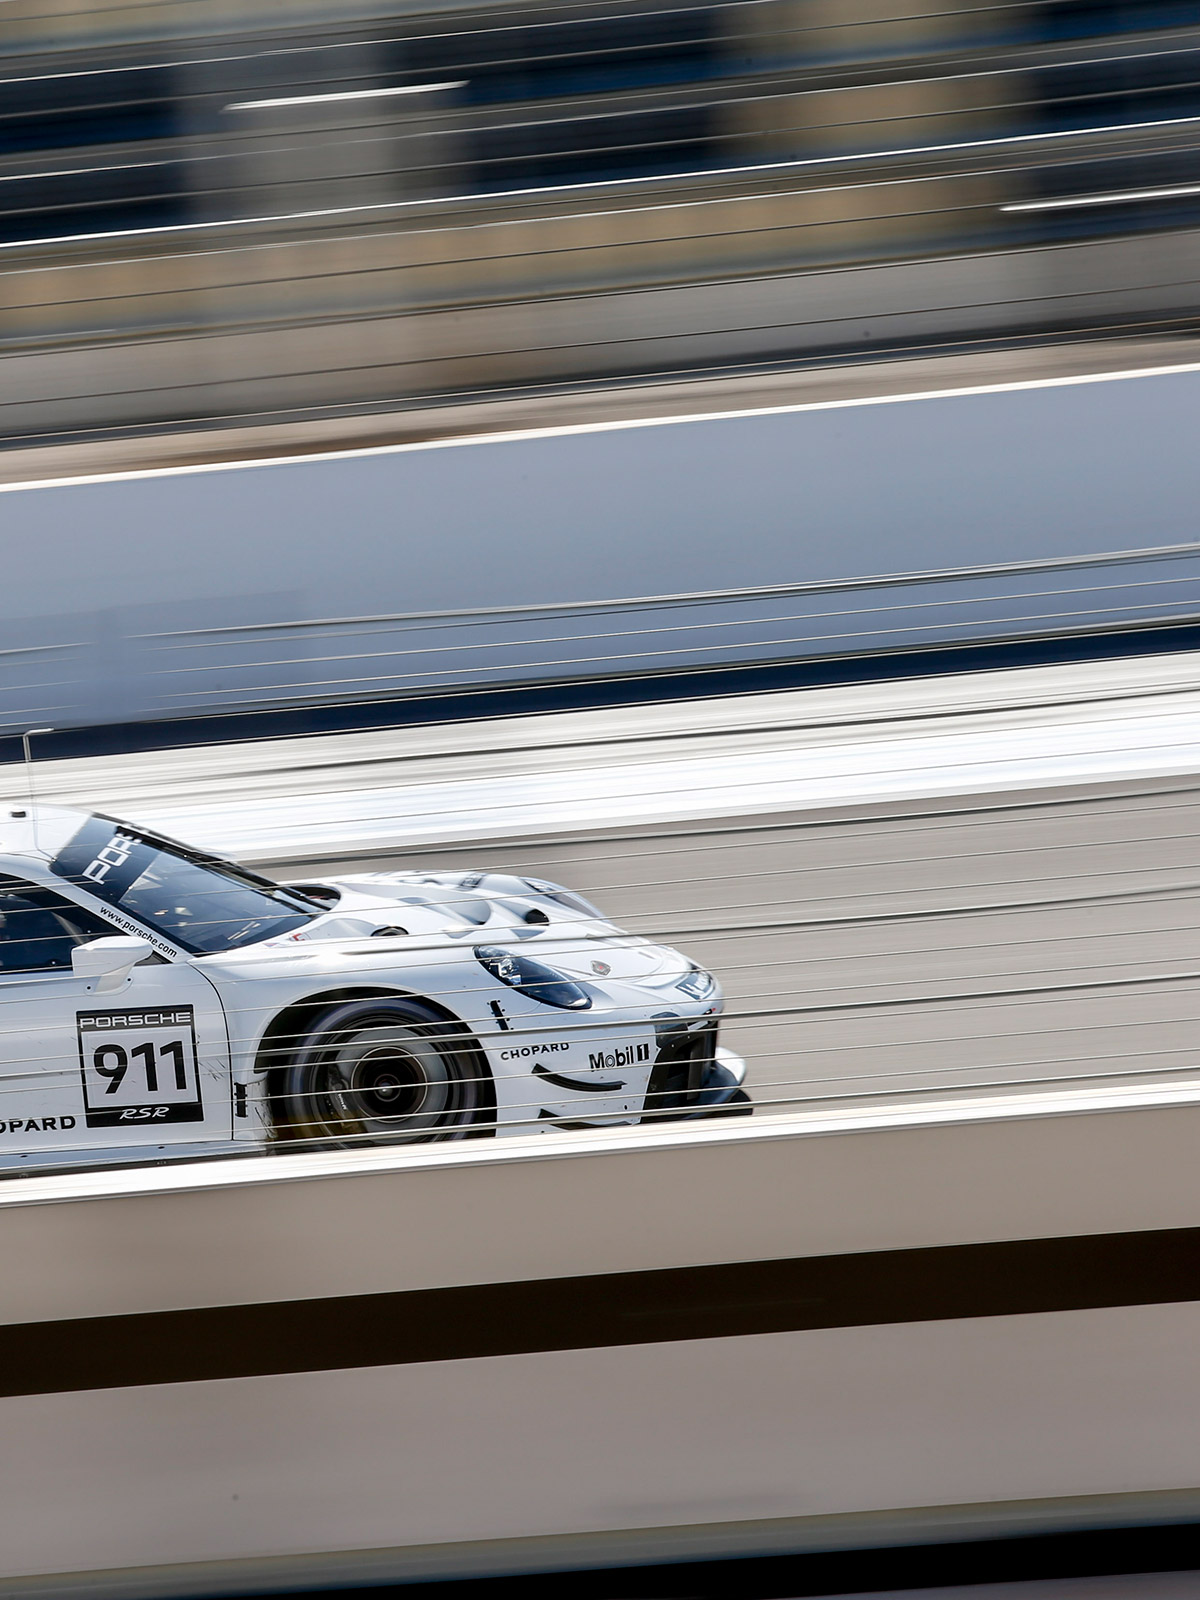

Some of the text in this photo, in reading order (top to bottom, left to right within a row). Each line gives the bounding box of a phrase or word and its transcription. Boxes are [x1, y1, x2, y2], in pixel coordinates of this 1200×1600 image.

[100, 906, 177, 957] www.porsche.com
[80, 1012, 191, 1028] PORSCHE
[500, 1042, 570, 1061] CHOPARD
[588, 1045, 634, 1072] Mobil
[93, 1040, 187, 1094] 911
[119, 1106, 170, 1120] RSR
